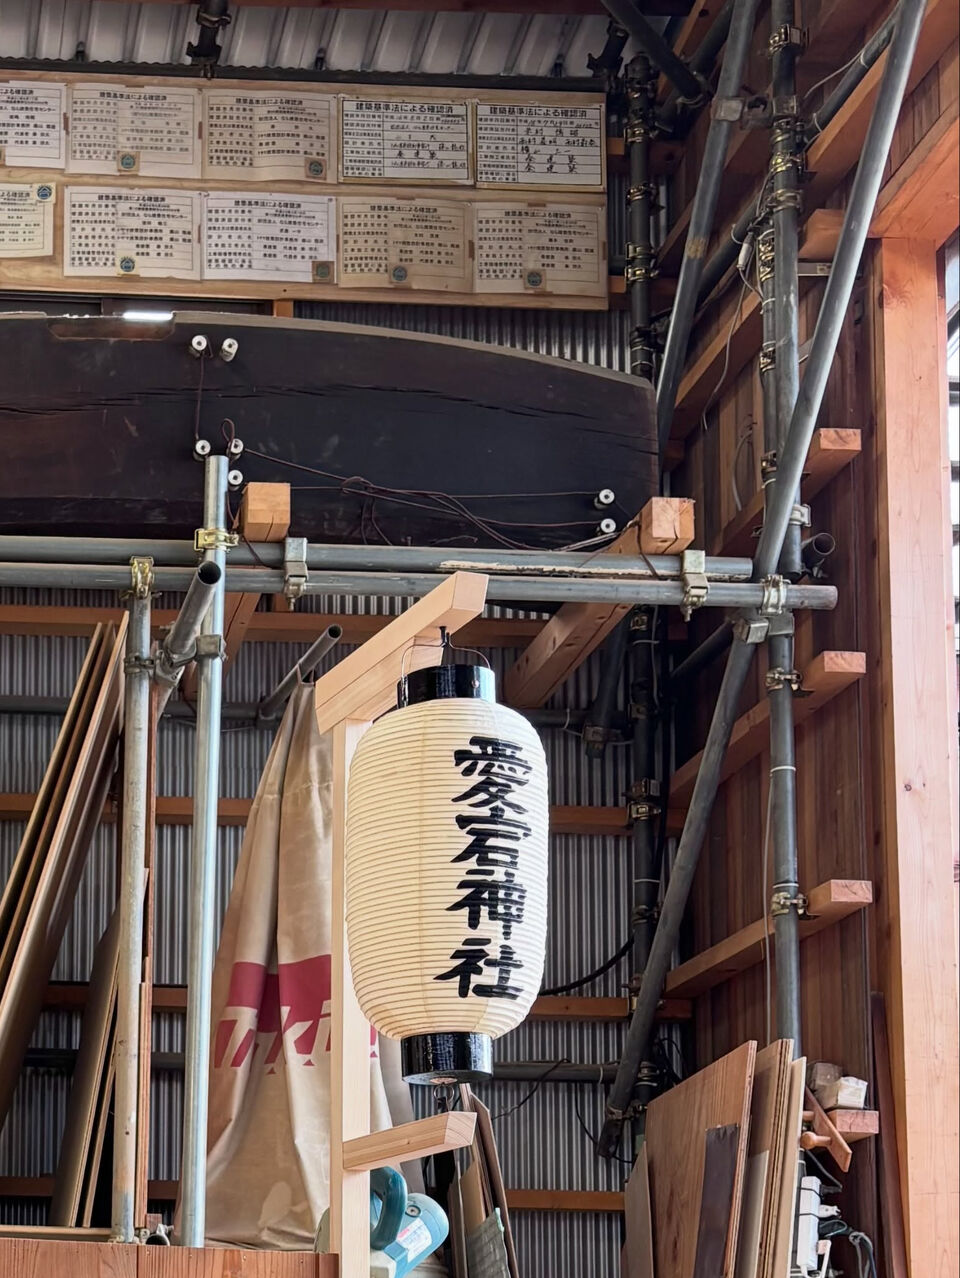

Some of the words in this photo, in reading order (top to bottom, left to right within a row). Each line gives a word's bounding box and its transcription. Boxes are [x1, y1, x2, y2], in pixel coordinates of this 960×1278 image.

[355, 102, 454, 114] 建築基準法による確認済
[489, 106, 588, 118] 建築基準法による確認済
[433, 735, 533, 1001] 愛宕神社
